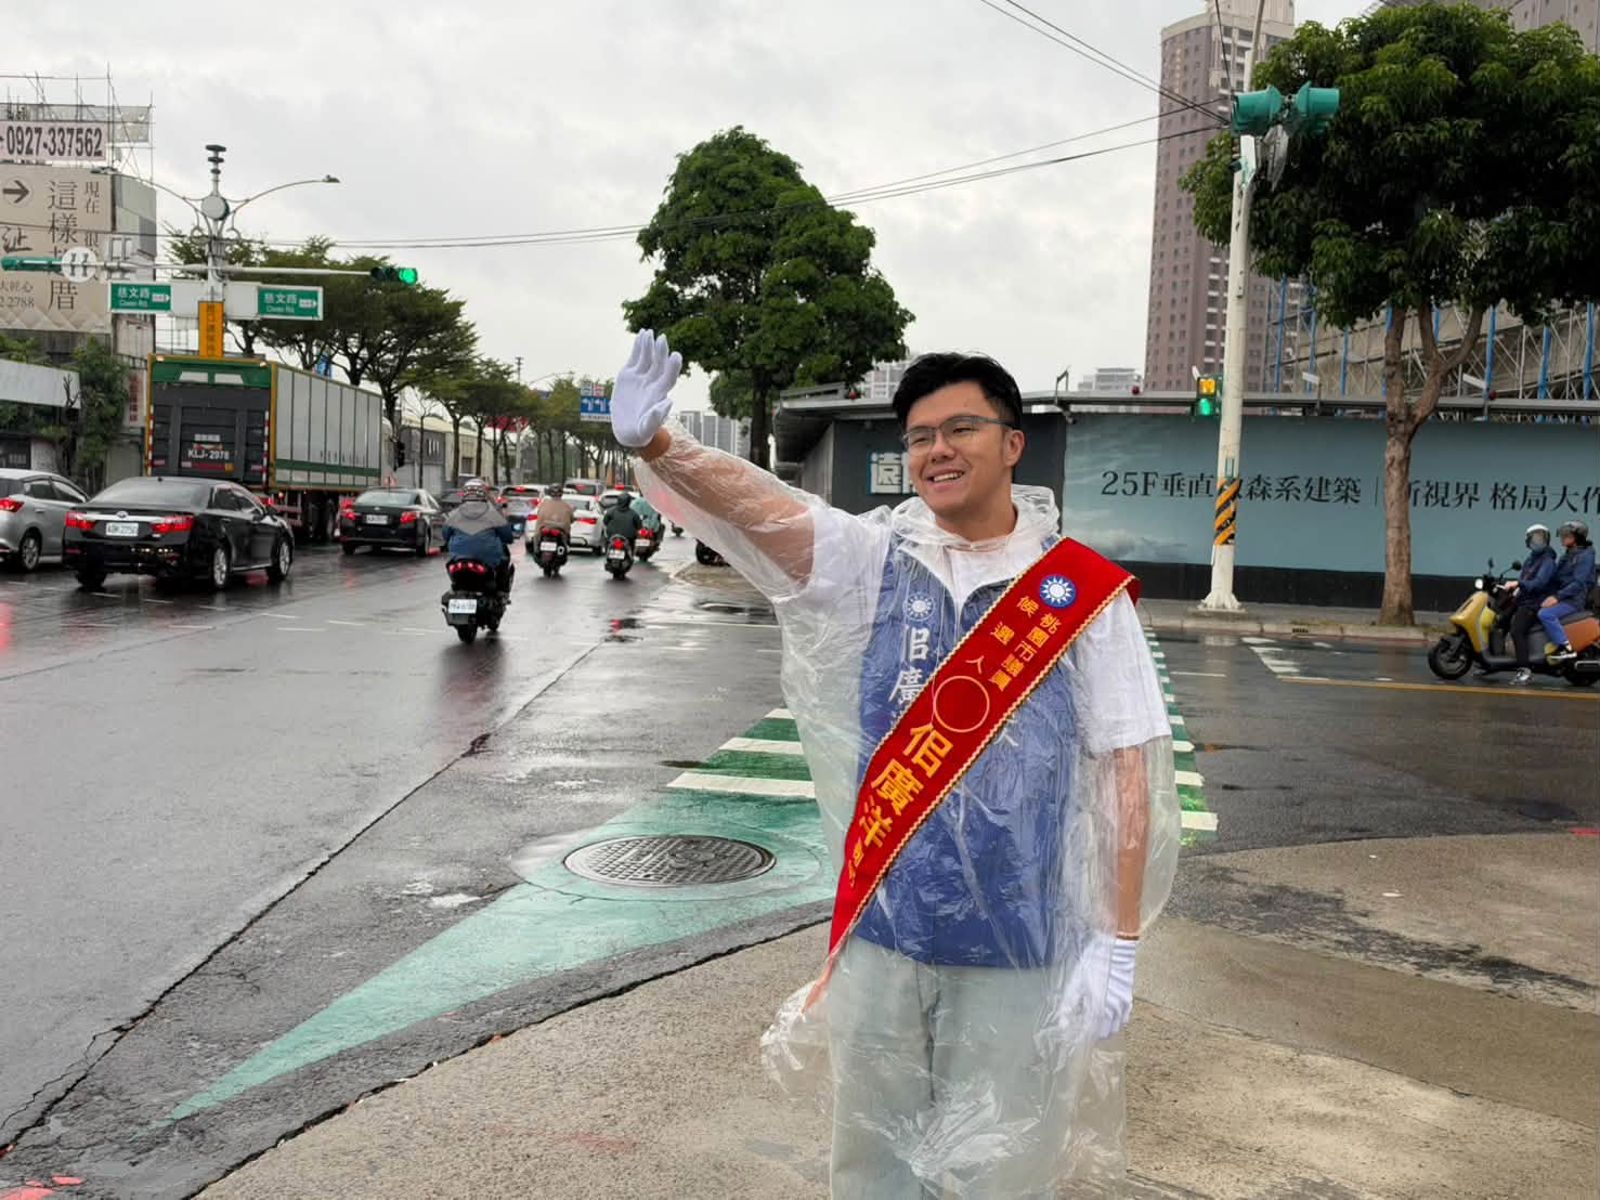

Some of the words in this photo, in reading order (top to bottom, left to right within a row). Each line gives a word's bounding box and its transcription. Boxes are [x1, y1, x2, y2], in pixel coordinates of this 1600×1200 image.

[6, 125, 103, 157] 0927-337562
[84, 181, 100, 215] 現在
[47, 181, 79, 311] 這樣厝
[1101, 470, 1362, 505] 25F垂直森系建築
[966, 595, 1040, 675] 候選人
[987, 612, 1062, 692] 桃園市議員
